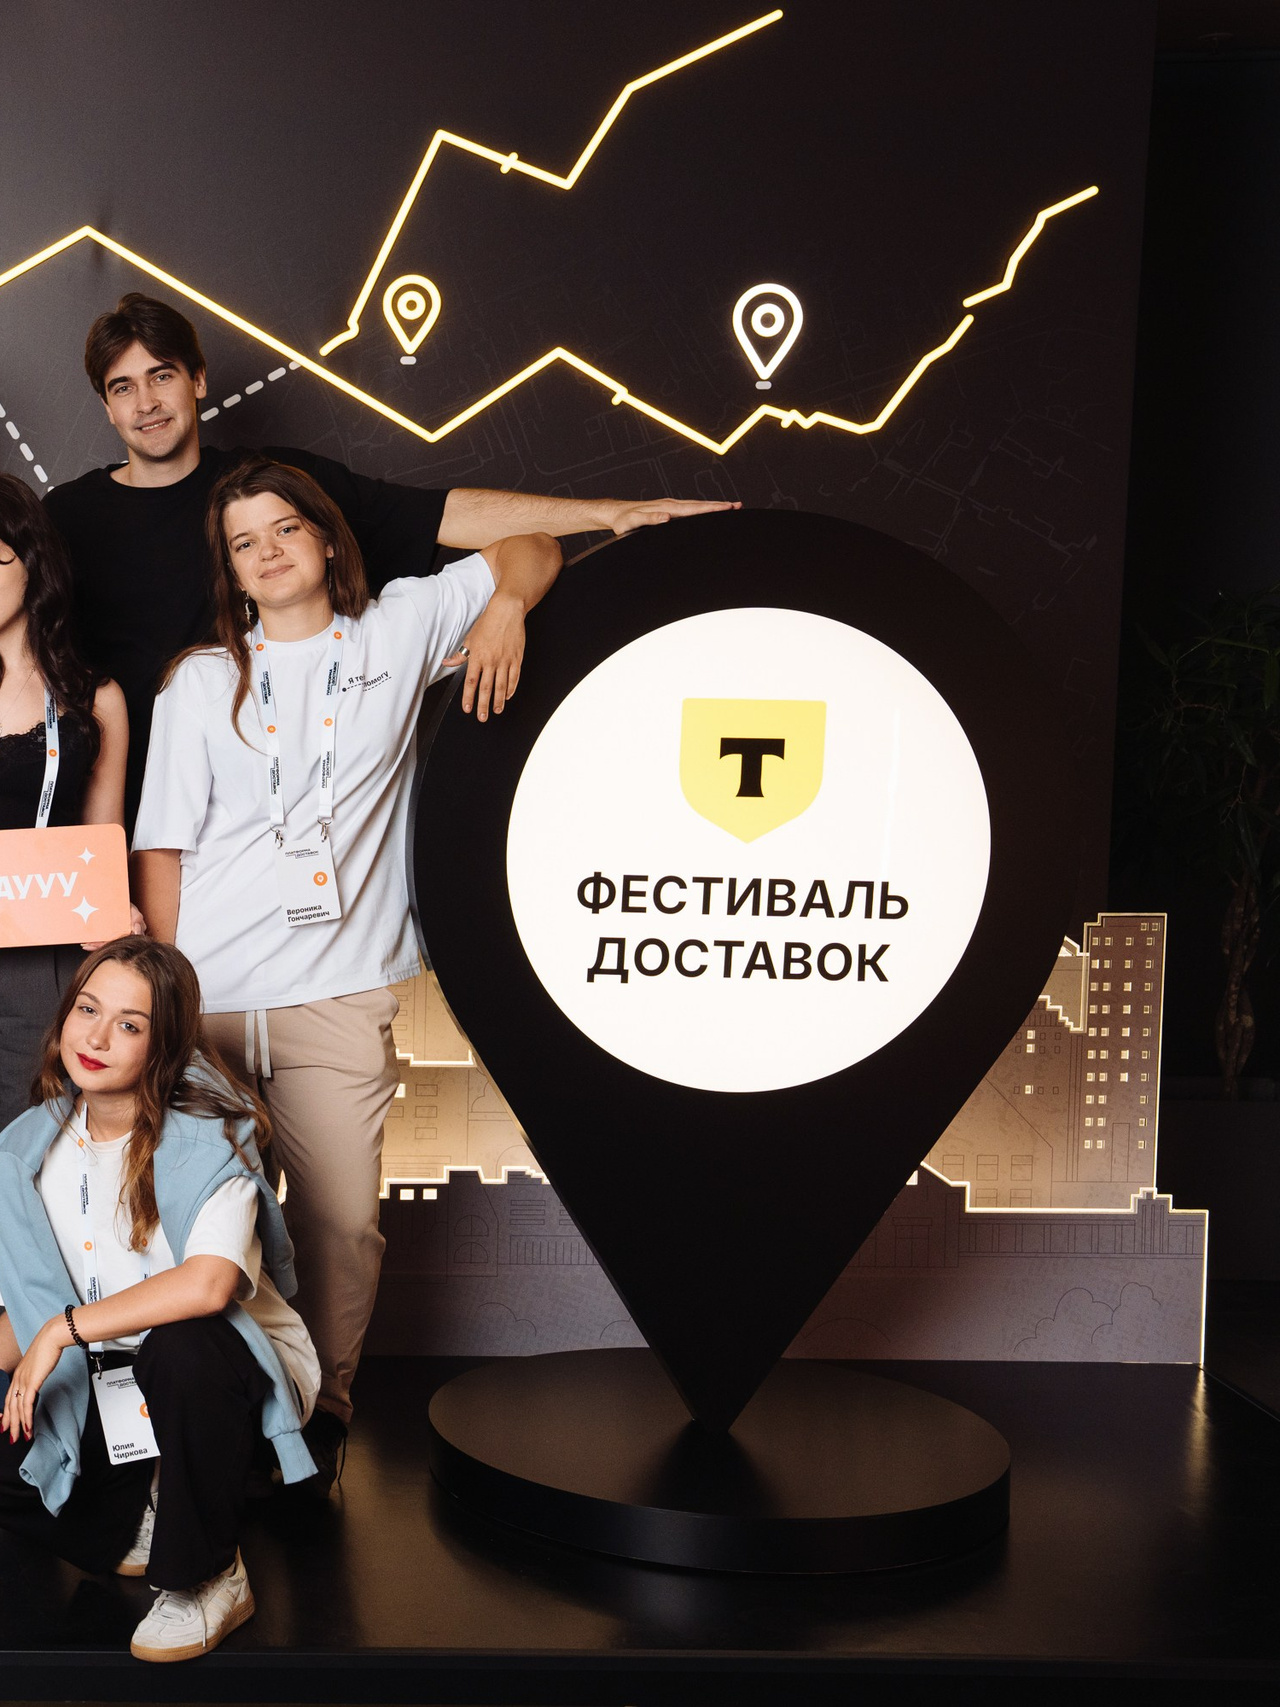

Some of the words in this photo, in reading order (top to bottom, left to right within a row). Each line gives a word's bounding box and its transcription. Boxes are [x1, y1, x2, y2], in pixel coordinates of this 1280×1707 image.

[720, 737, 785, 798] Т
[577, 872, 909, 920] ФЕСТИВАЛЬ
[286, 904, 322, 915] Вероника
[288, 911, 330, 922] Гончаревич
[587, 936, 891, 984] ДОСТАВОК
[112, 1442, 135, 1452] Юлия
[114, 1448, 148, 1460] Чиркова
